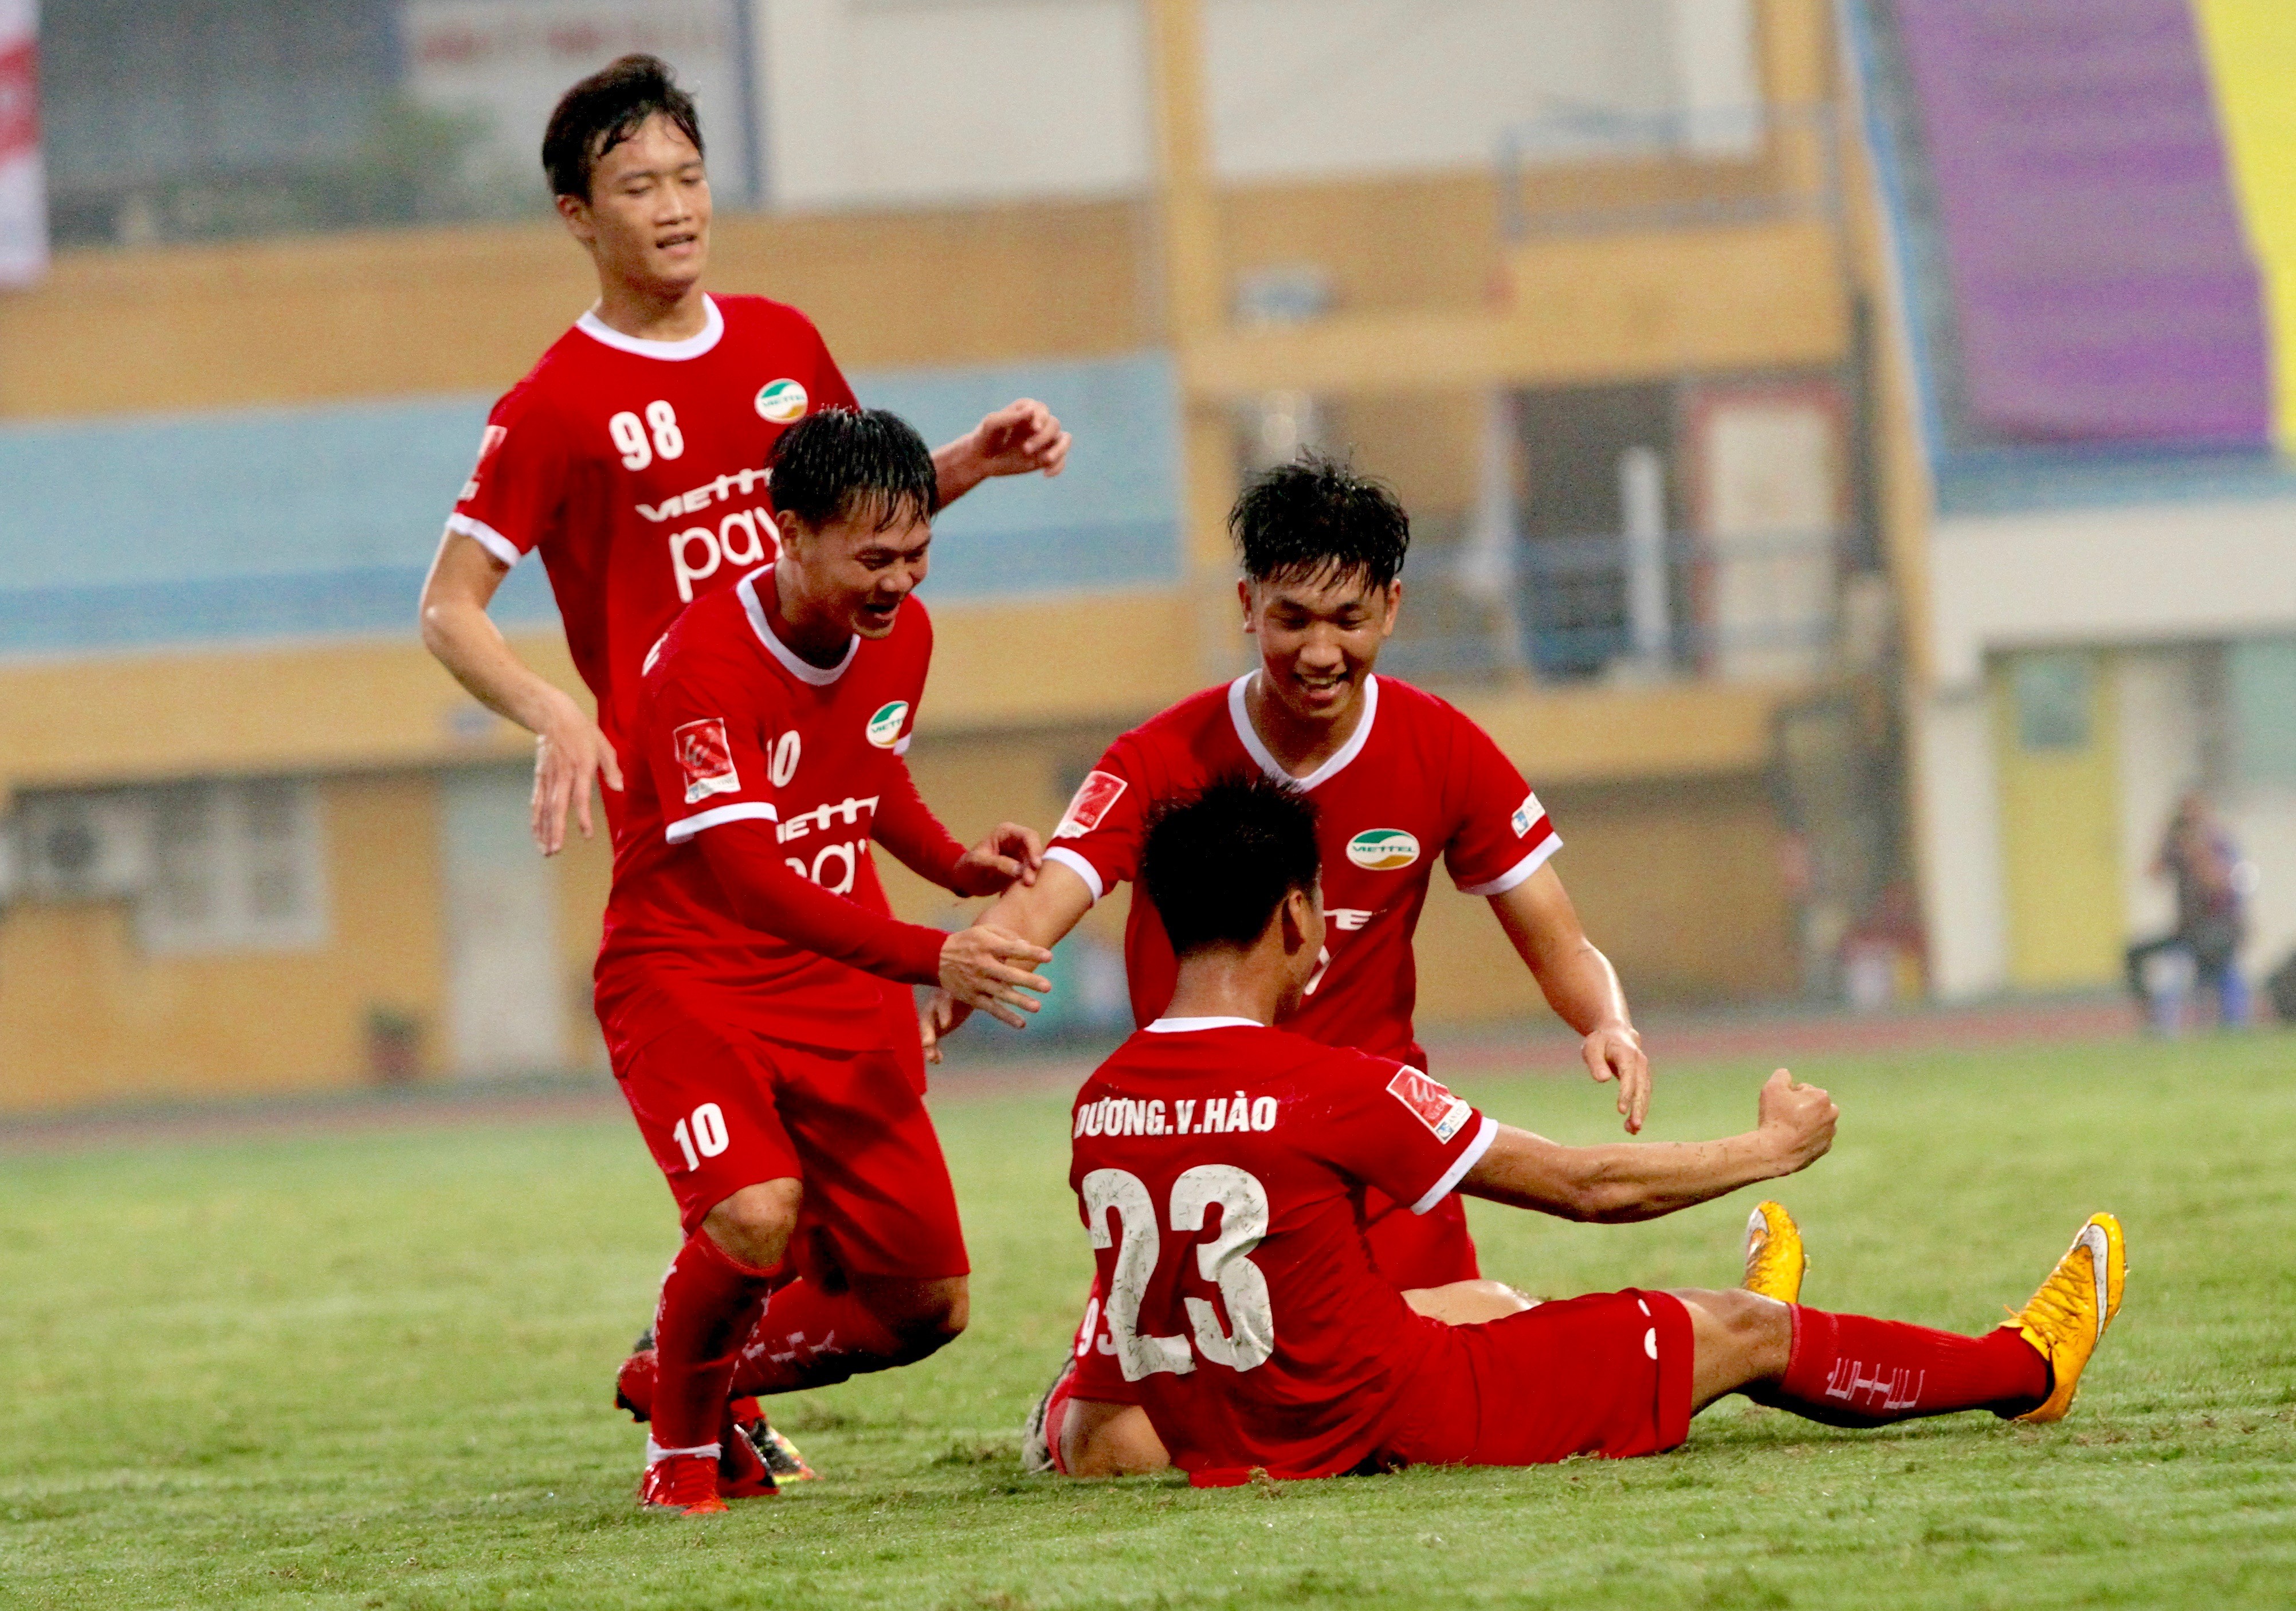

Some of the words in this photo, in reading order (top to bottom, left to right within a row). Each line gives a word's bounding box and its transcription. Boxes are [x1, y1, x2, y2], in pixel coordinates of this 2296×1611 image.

[609, 399, 684, 472] 98
[634, 467, 774, 522] VIETT
[673, 1103, 729, 1172] 10
[1081, 1163, 1274, 1382] 23
